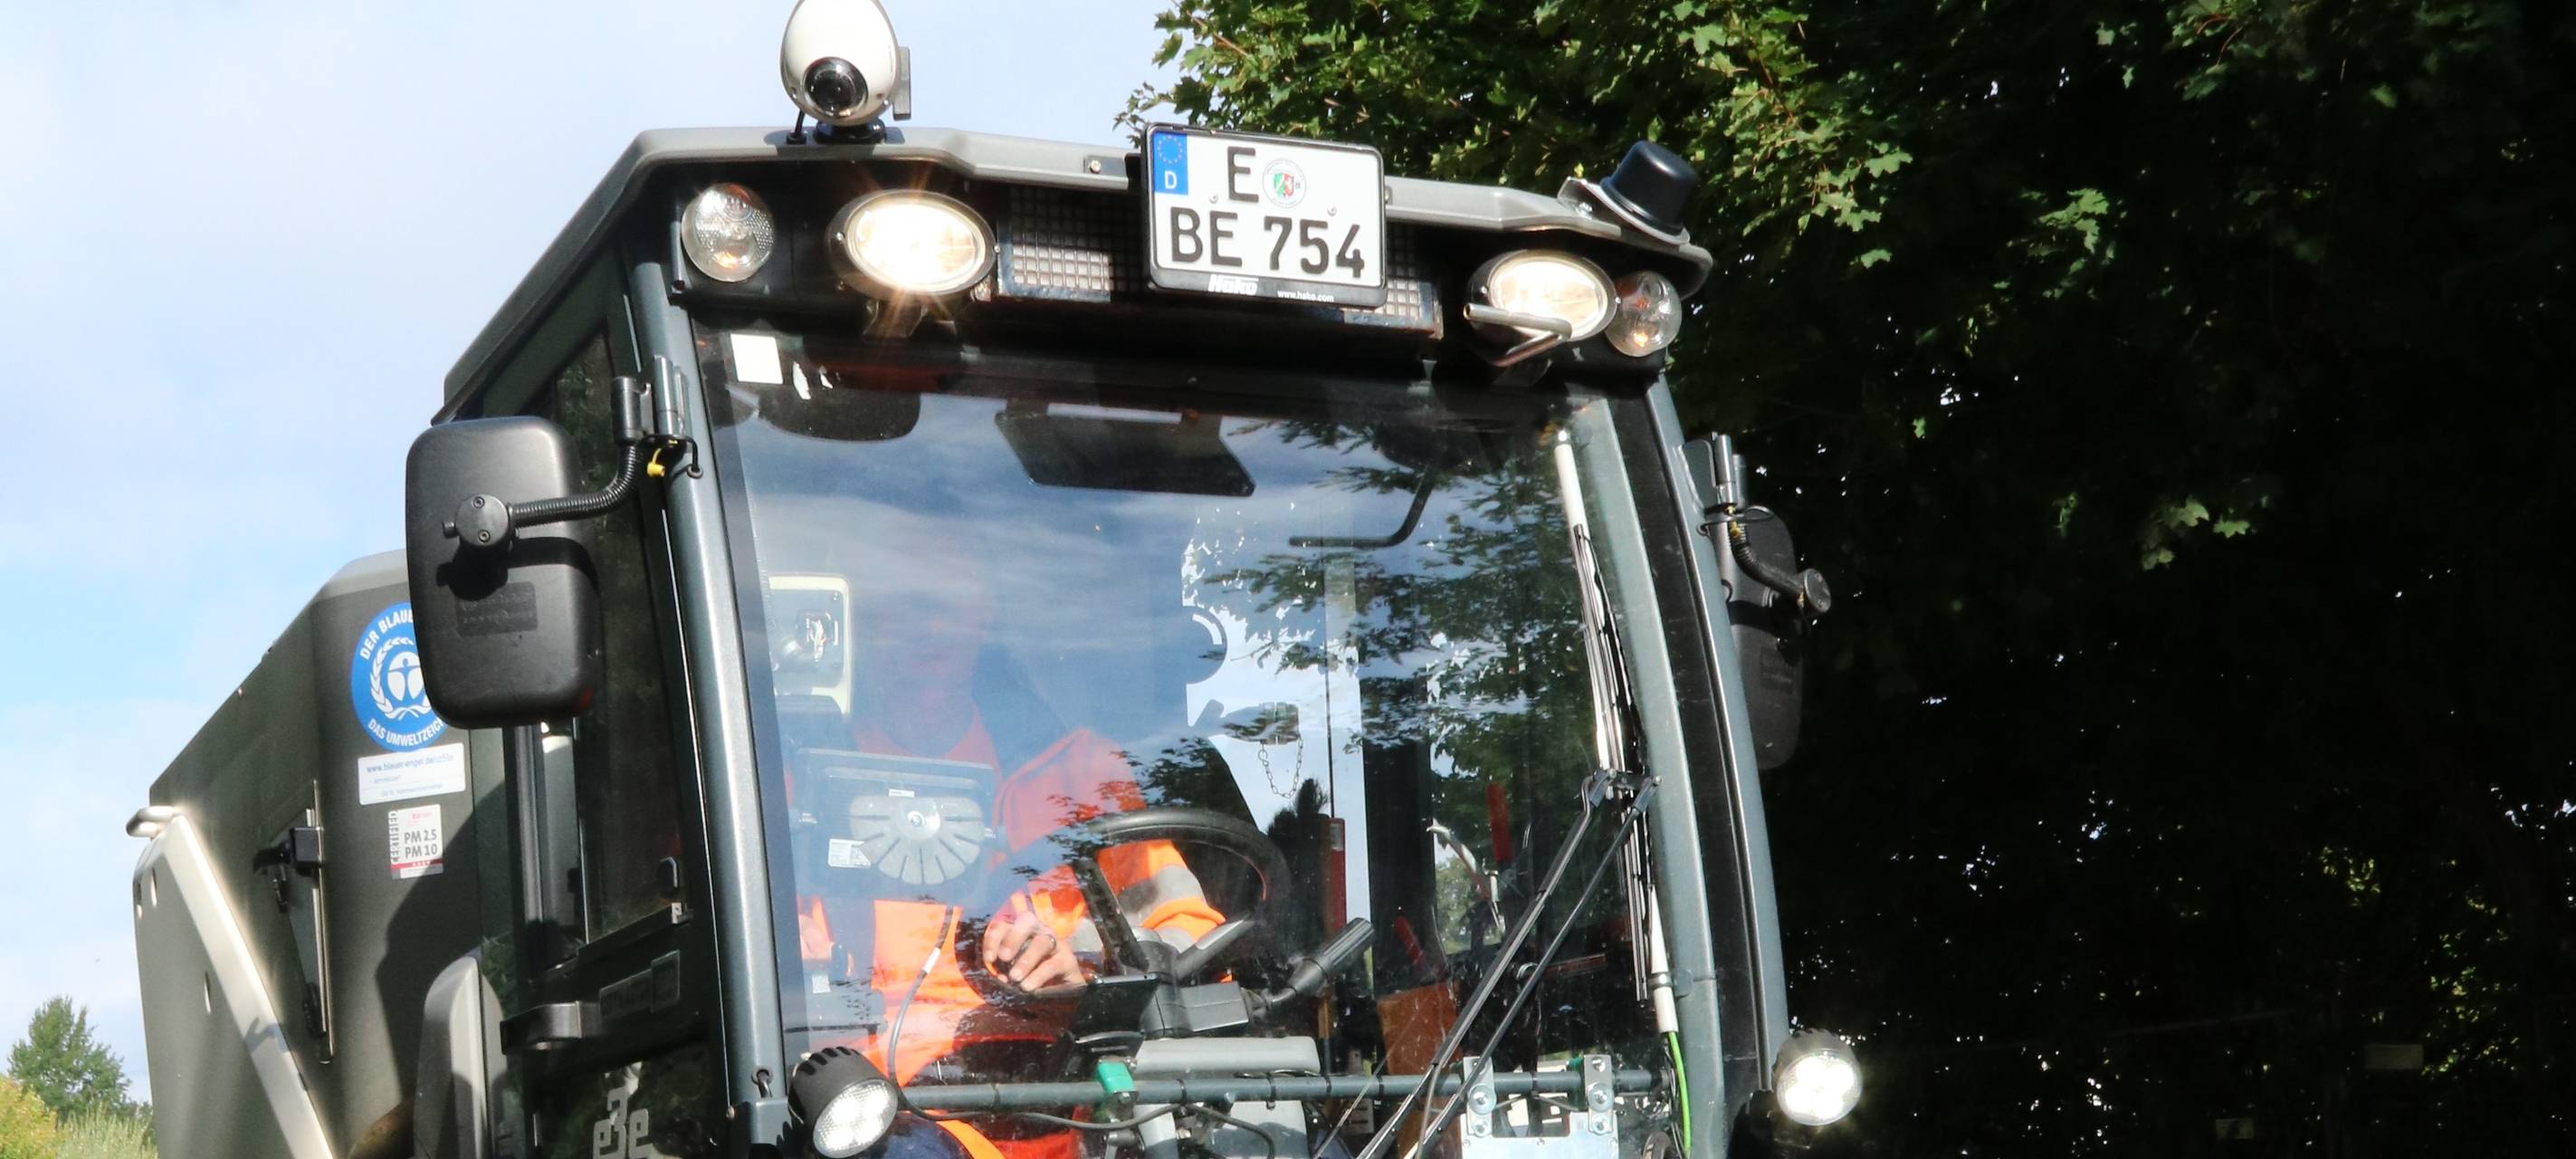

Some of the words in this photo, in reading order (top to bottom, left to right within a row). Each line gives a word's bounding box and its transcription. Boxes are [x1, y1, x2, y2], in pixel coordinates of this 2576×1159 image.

[1164, 170, 1178, 190] D
[1226, 146, 1260, 204] E
[1169, 206, 1243, 268] BE
[1264, 215, 1365, 279] 754
[1207, 273, 1259, 296] Hako
[1277, 290, 1334, 302] www.hako.com
[359, 629, 380, 660] DER
[367, 718, 386, 740] DAS
[404, 830, 422, 844] PM
[405, 846, 423, 858] PM
[425, 843, 438, 856] 10
